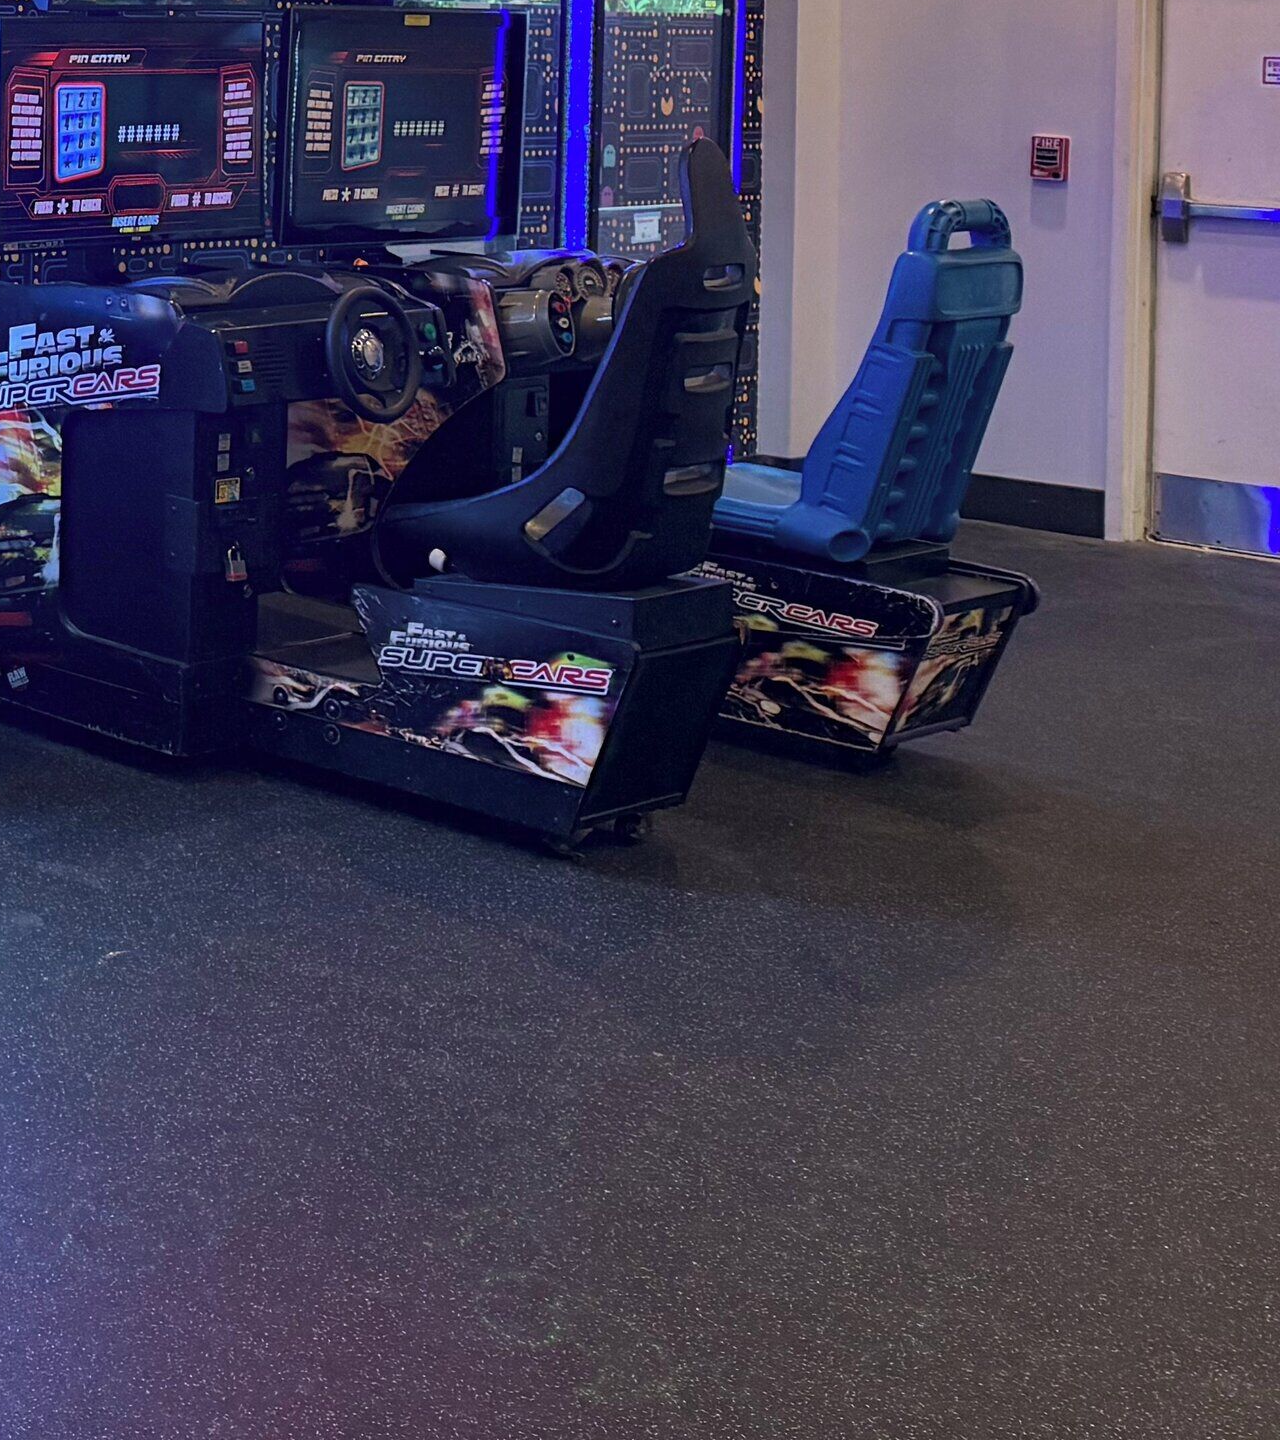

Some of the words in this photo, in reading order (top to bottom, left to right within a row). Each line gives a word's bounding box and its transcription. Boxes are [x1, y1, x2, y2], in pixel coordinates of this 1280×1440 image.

[69, 54, 89, 63] PIN
[90, 54, 130, 64] ENTRY
[356, 54, 373, 63] PIN
[374, 55, 407, 63] ENTRY
[1035, 137, 1061, 148] FIRE
[192, 192, 201, 207] #
[385, 205, 407, 215] INSERT
[406, 204, 425, 214] COINS
[111, 216, 137, 227] INSERT
[138, 215, 159, 226] COINS
[9, 323, 95, 359] FAST
[702, 561, 746, 579] FAST
[407, 622, 456, 639] FAST
[390, 630, 470, 652] FURIOUS
[7, 667, 26, 682] RAW
